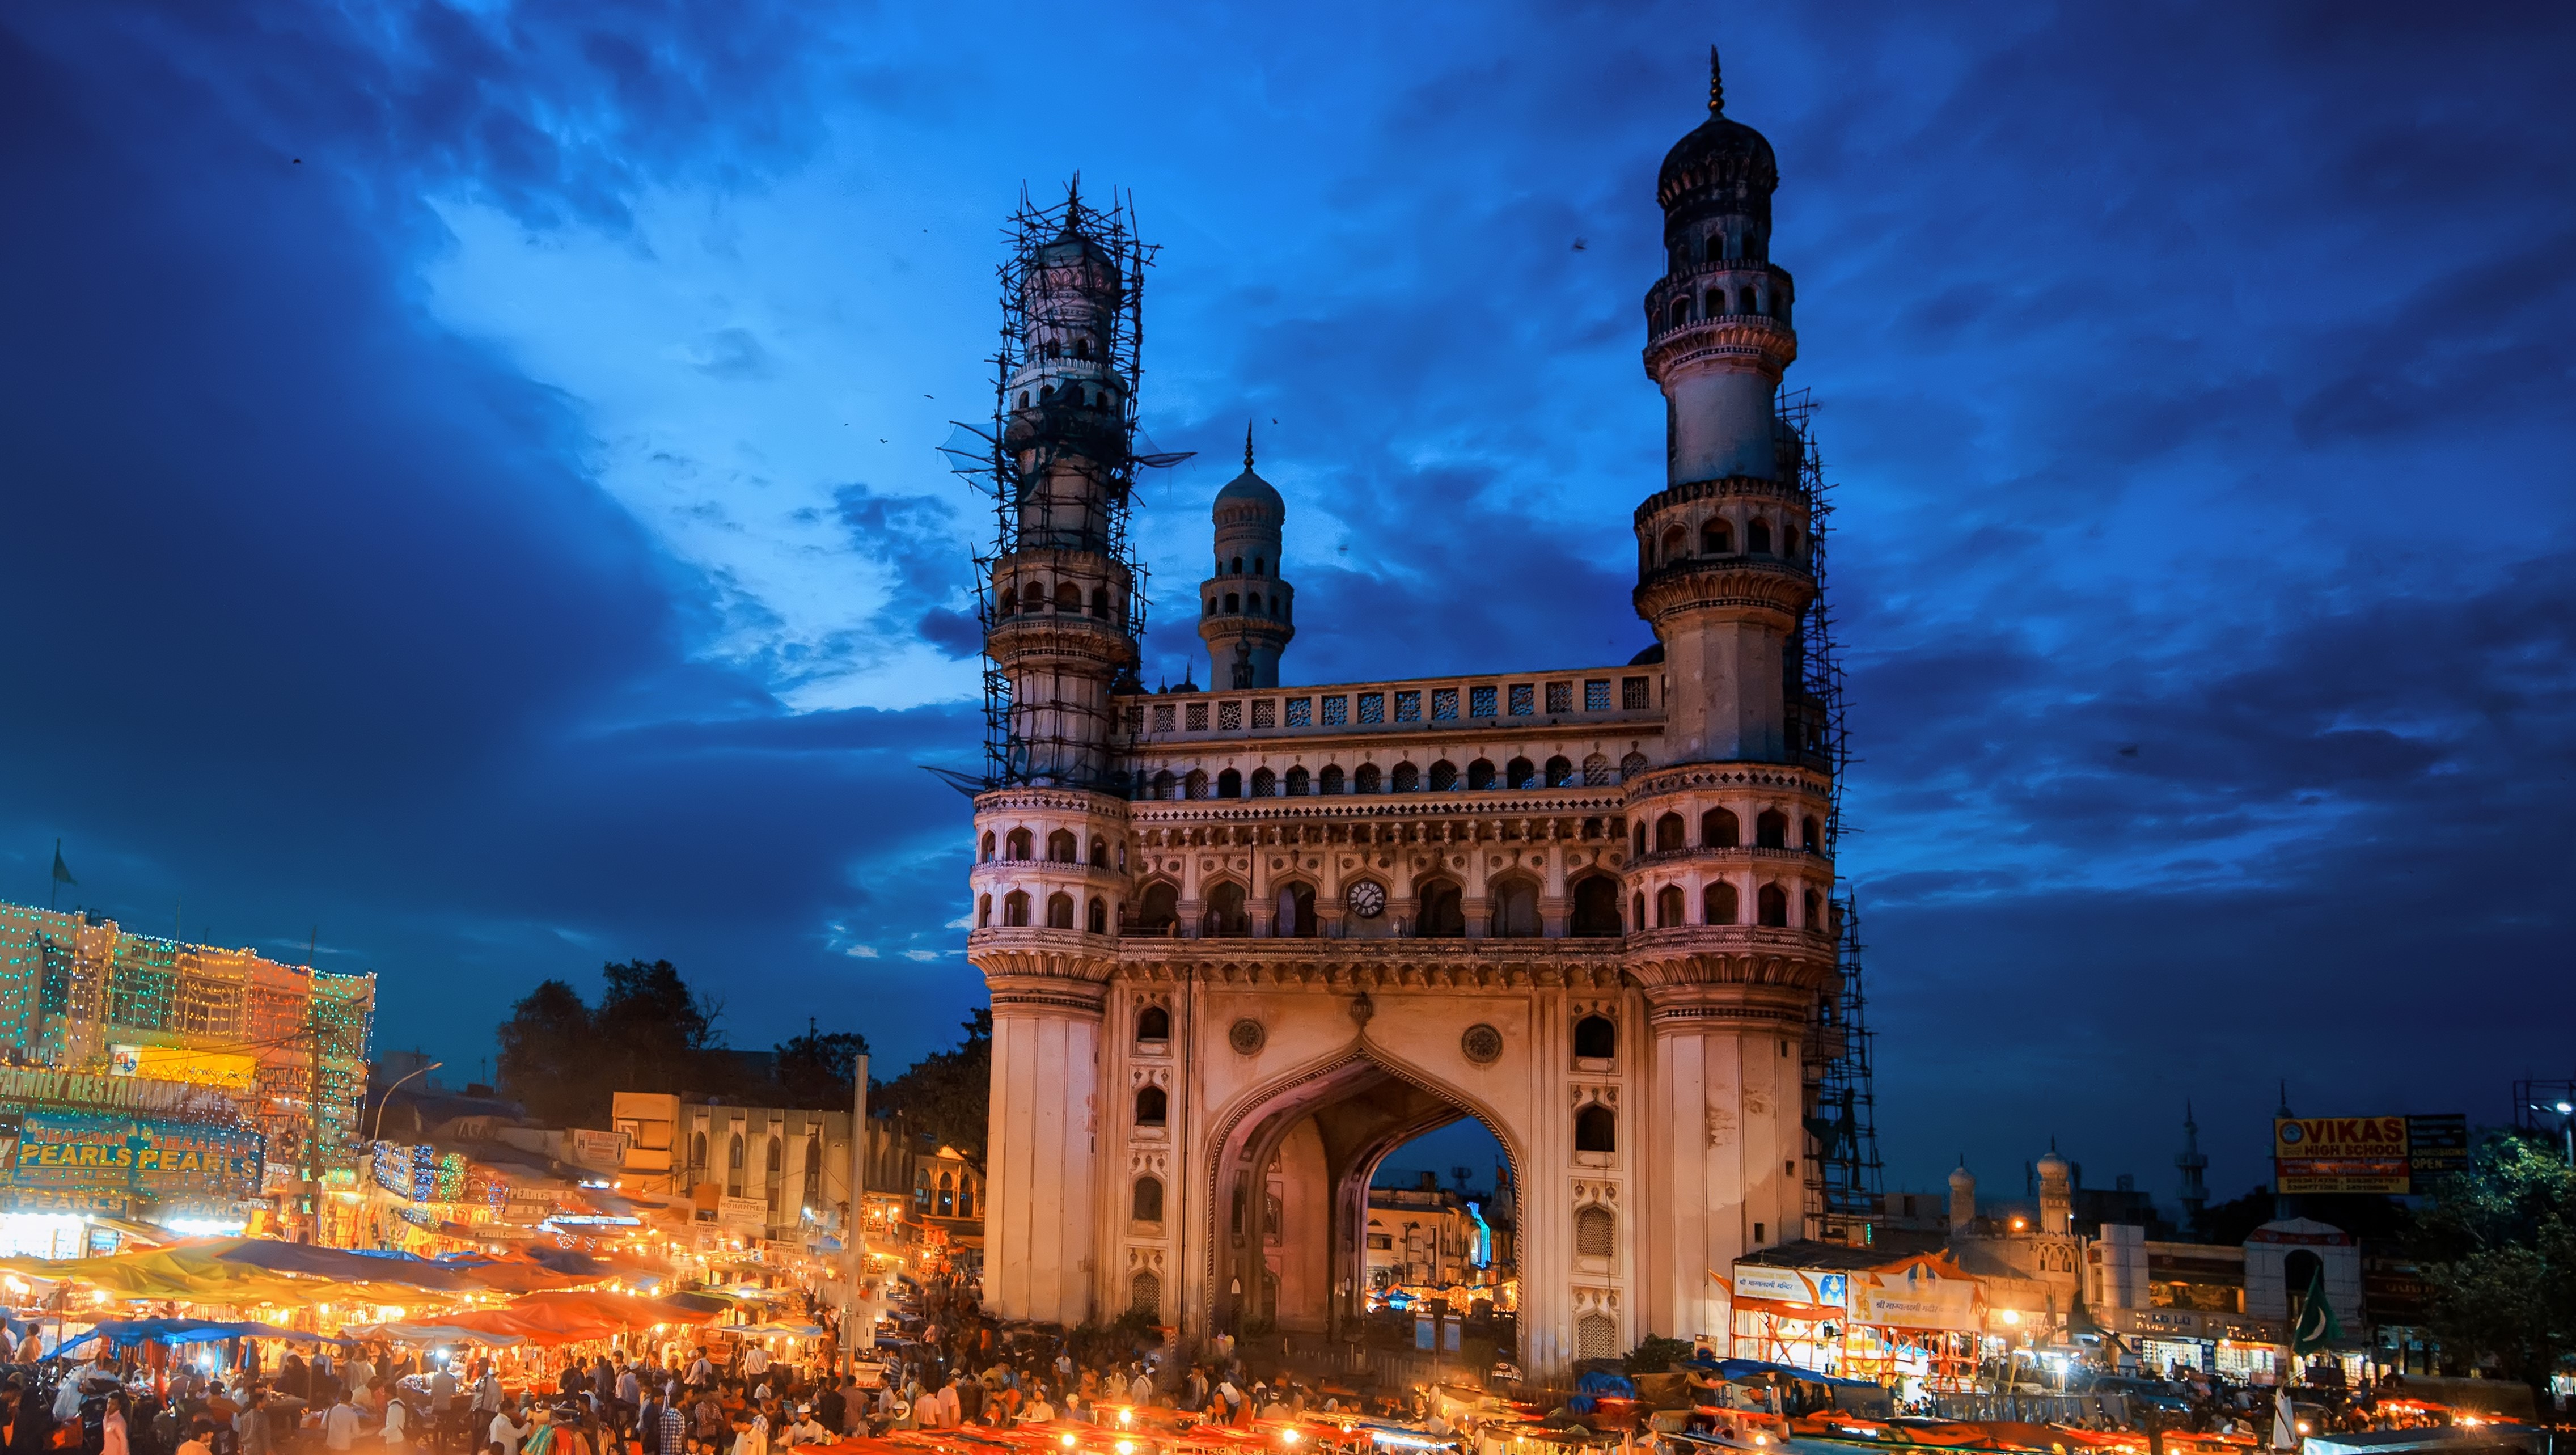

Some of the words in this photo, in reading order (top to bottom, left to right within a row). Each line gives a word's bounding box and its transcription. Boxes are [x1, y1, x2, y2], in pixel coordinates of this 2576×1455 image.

[67, 1073, 189, 1113] RESTAURANT
[34, 1127, 129, 1146] SHAADAN
[2303, 1119, 2404, 1143] VIKAS
[19, 1144, 132, 1166] PEARLS
[2304, 1145, 2340, 1156] HIGH
[2345, 1144, 2404, 1156] SCHOOL
[2411, 1158, 2443, 1169] OPEN
[18, 1196, 123, 1210] PEARLS
[720, 1202, 767, 1212] MOHAMMED
